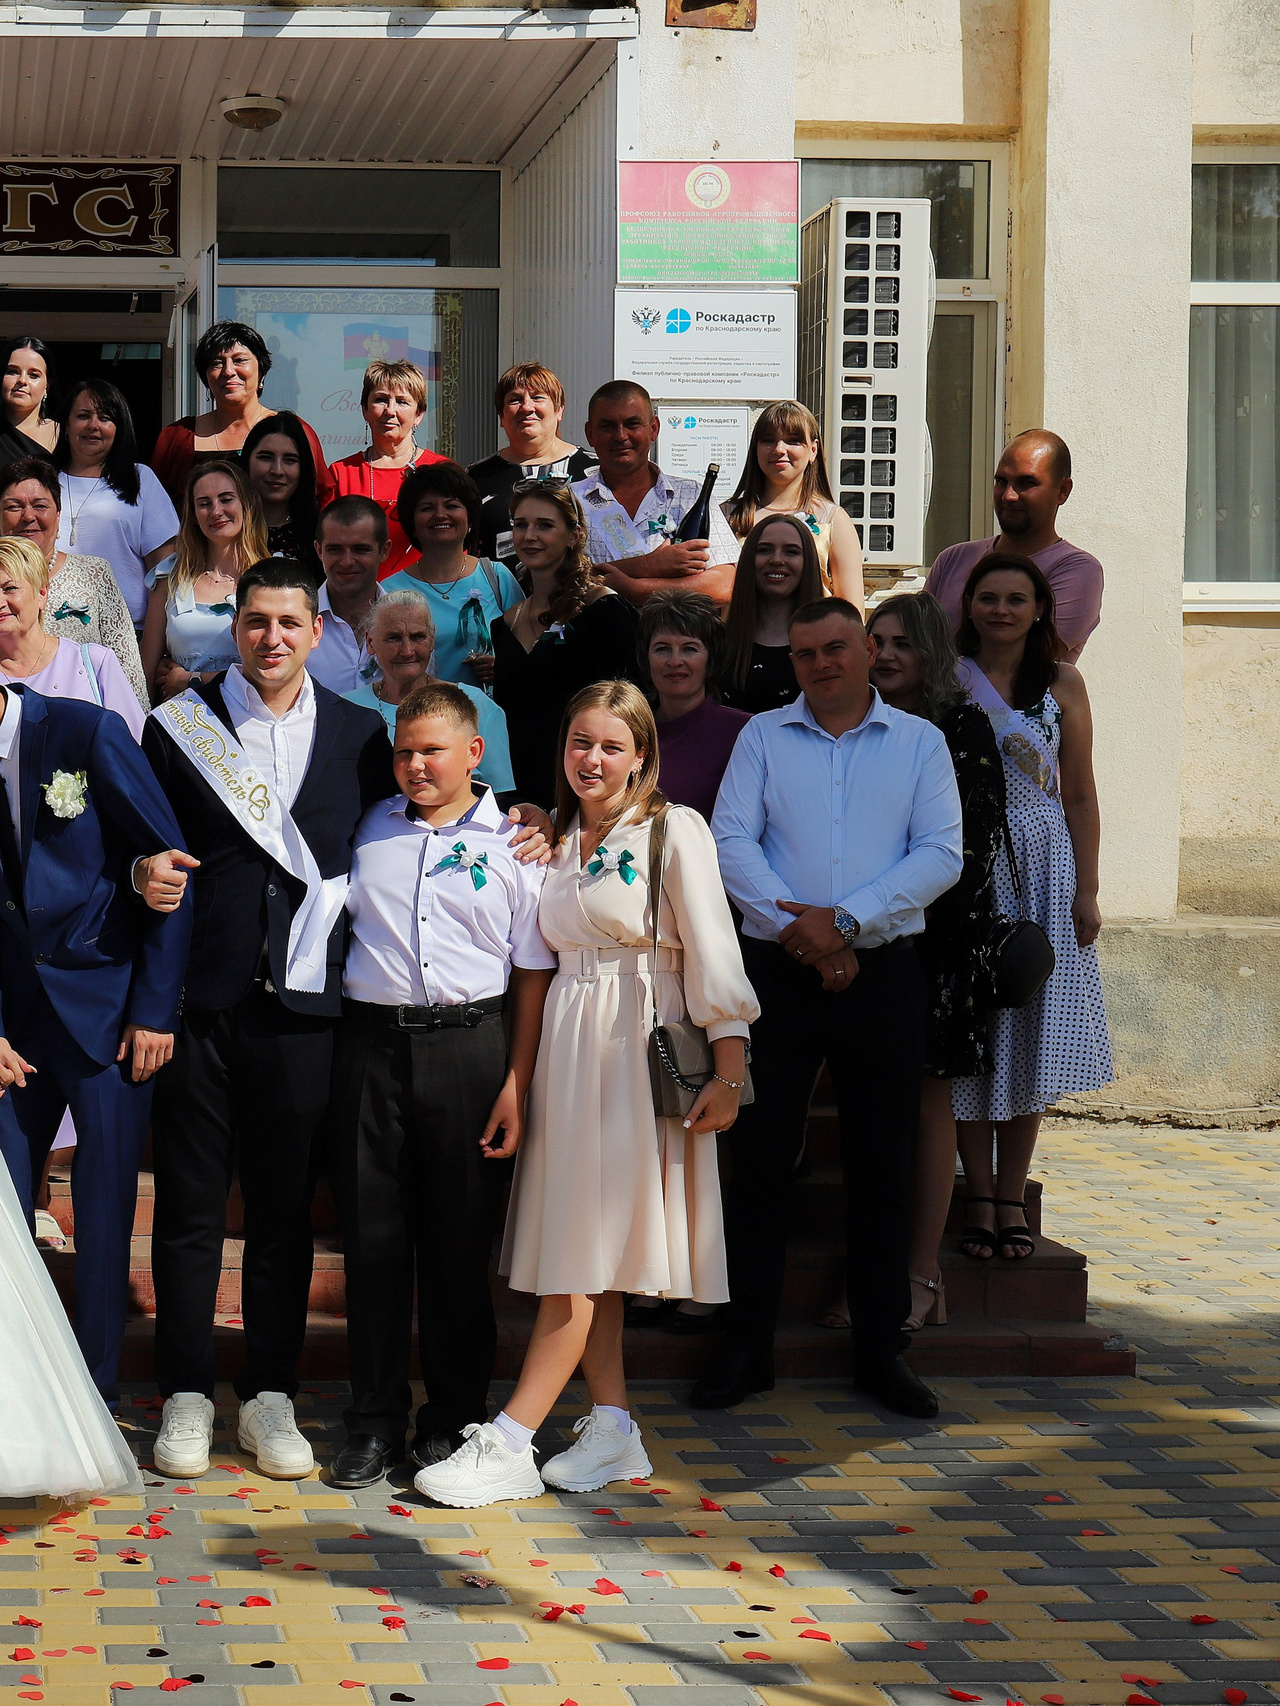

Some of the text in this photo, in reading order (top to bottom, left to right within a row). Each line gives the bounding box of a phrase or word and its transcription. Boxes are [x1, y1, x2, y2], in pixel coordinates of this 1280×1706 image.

[695, 311, 776, 325] Роскадастр
[705, 325, 762, 333] Краснодарскому
[192, 728, 247, 800] свидетель
